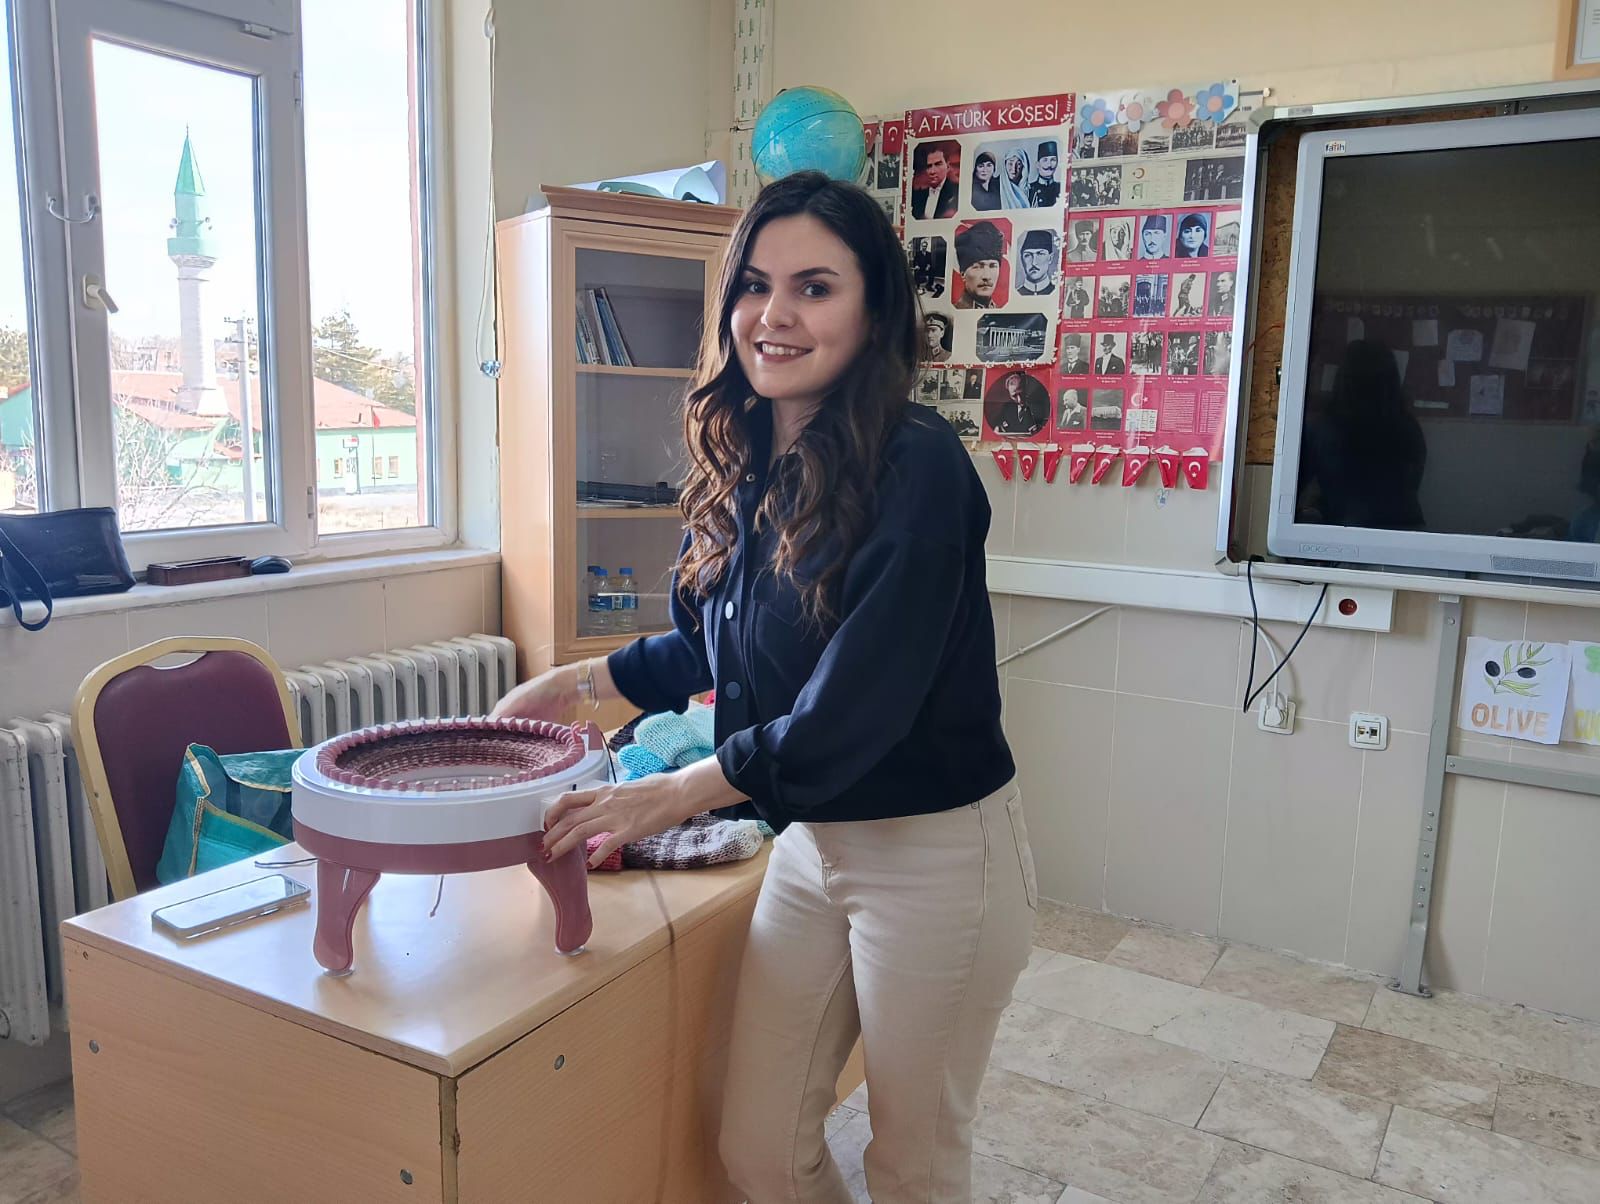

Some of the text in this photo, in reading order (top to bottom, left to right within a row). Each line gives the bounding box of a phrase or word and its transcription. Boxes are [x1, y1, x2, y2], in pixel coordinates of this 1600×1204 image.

[918, 99, 1058, 133] ATATÜRK KÖŞESİ
[1325, 141, 1345, 152] fatih
[1471, 703, 1549, 737] OLIVE
